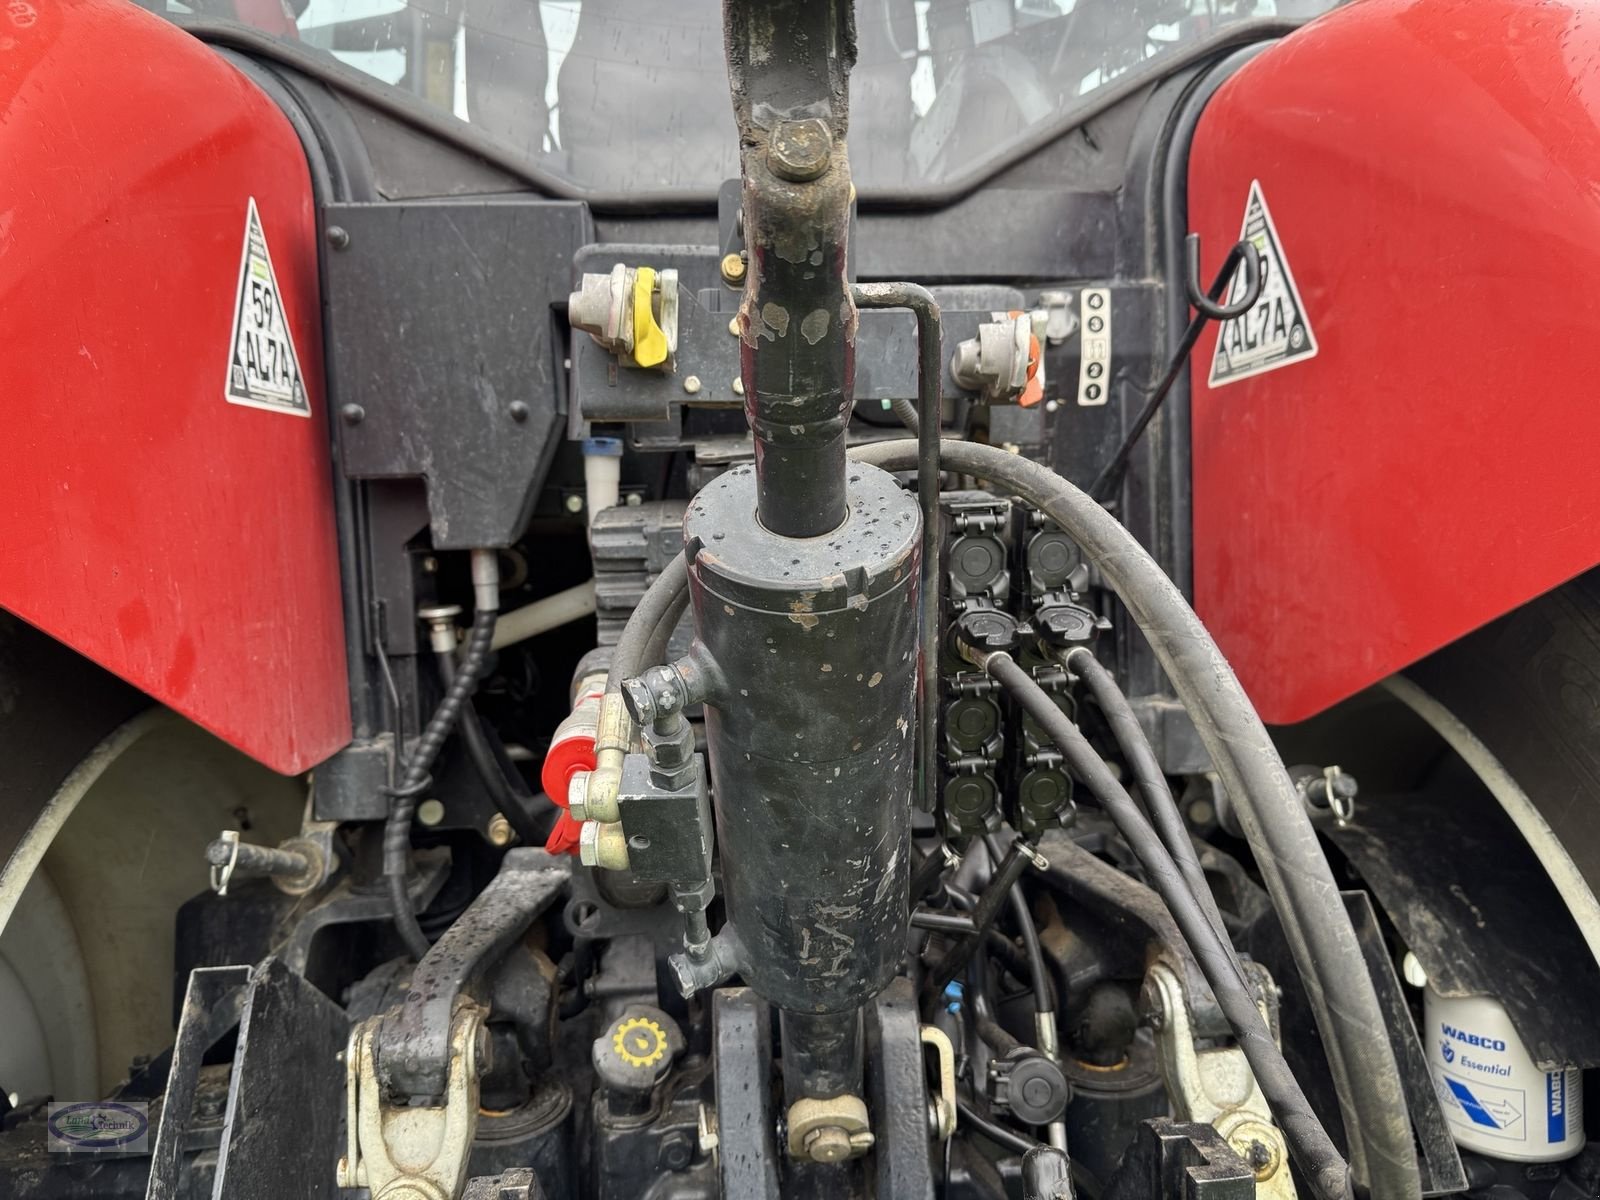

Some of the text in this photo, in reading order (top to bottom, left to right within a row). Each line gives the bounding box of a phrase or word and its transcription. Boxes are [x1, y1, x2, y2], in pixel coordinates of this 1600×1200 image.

[252, 280, 273, 331] 59
[1089, 293, 1102, 308] 4
[1089, 317, 1103, 332] 3
[1088, 363, 1102, 378] 2
[1087, 385, 1099, 399] 1
[1441, 1022, 1506, 1052] WABCO
[1460, 1055, 1512, 1077] Essential
[1551, 1071, 1562, 1117] WABC
